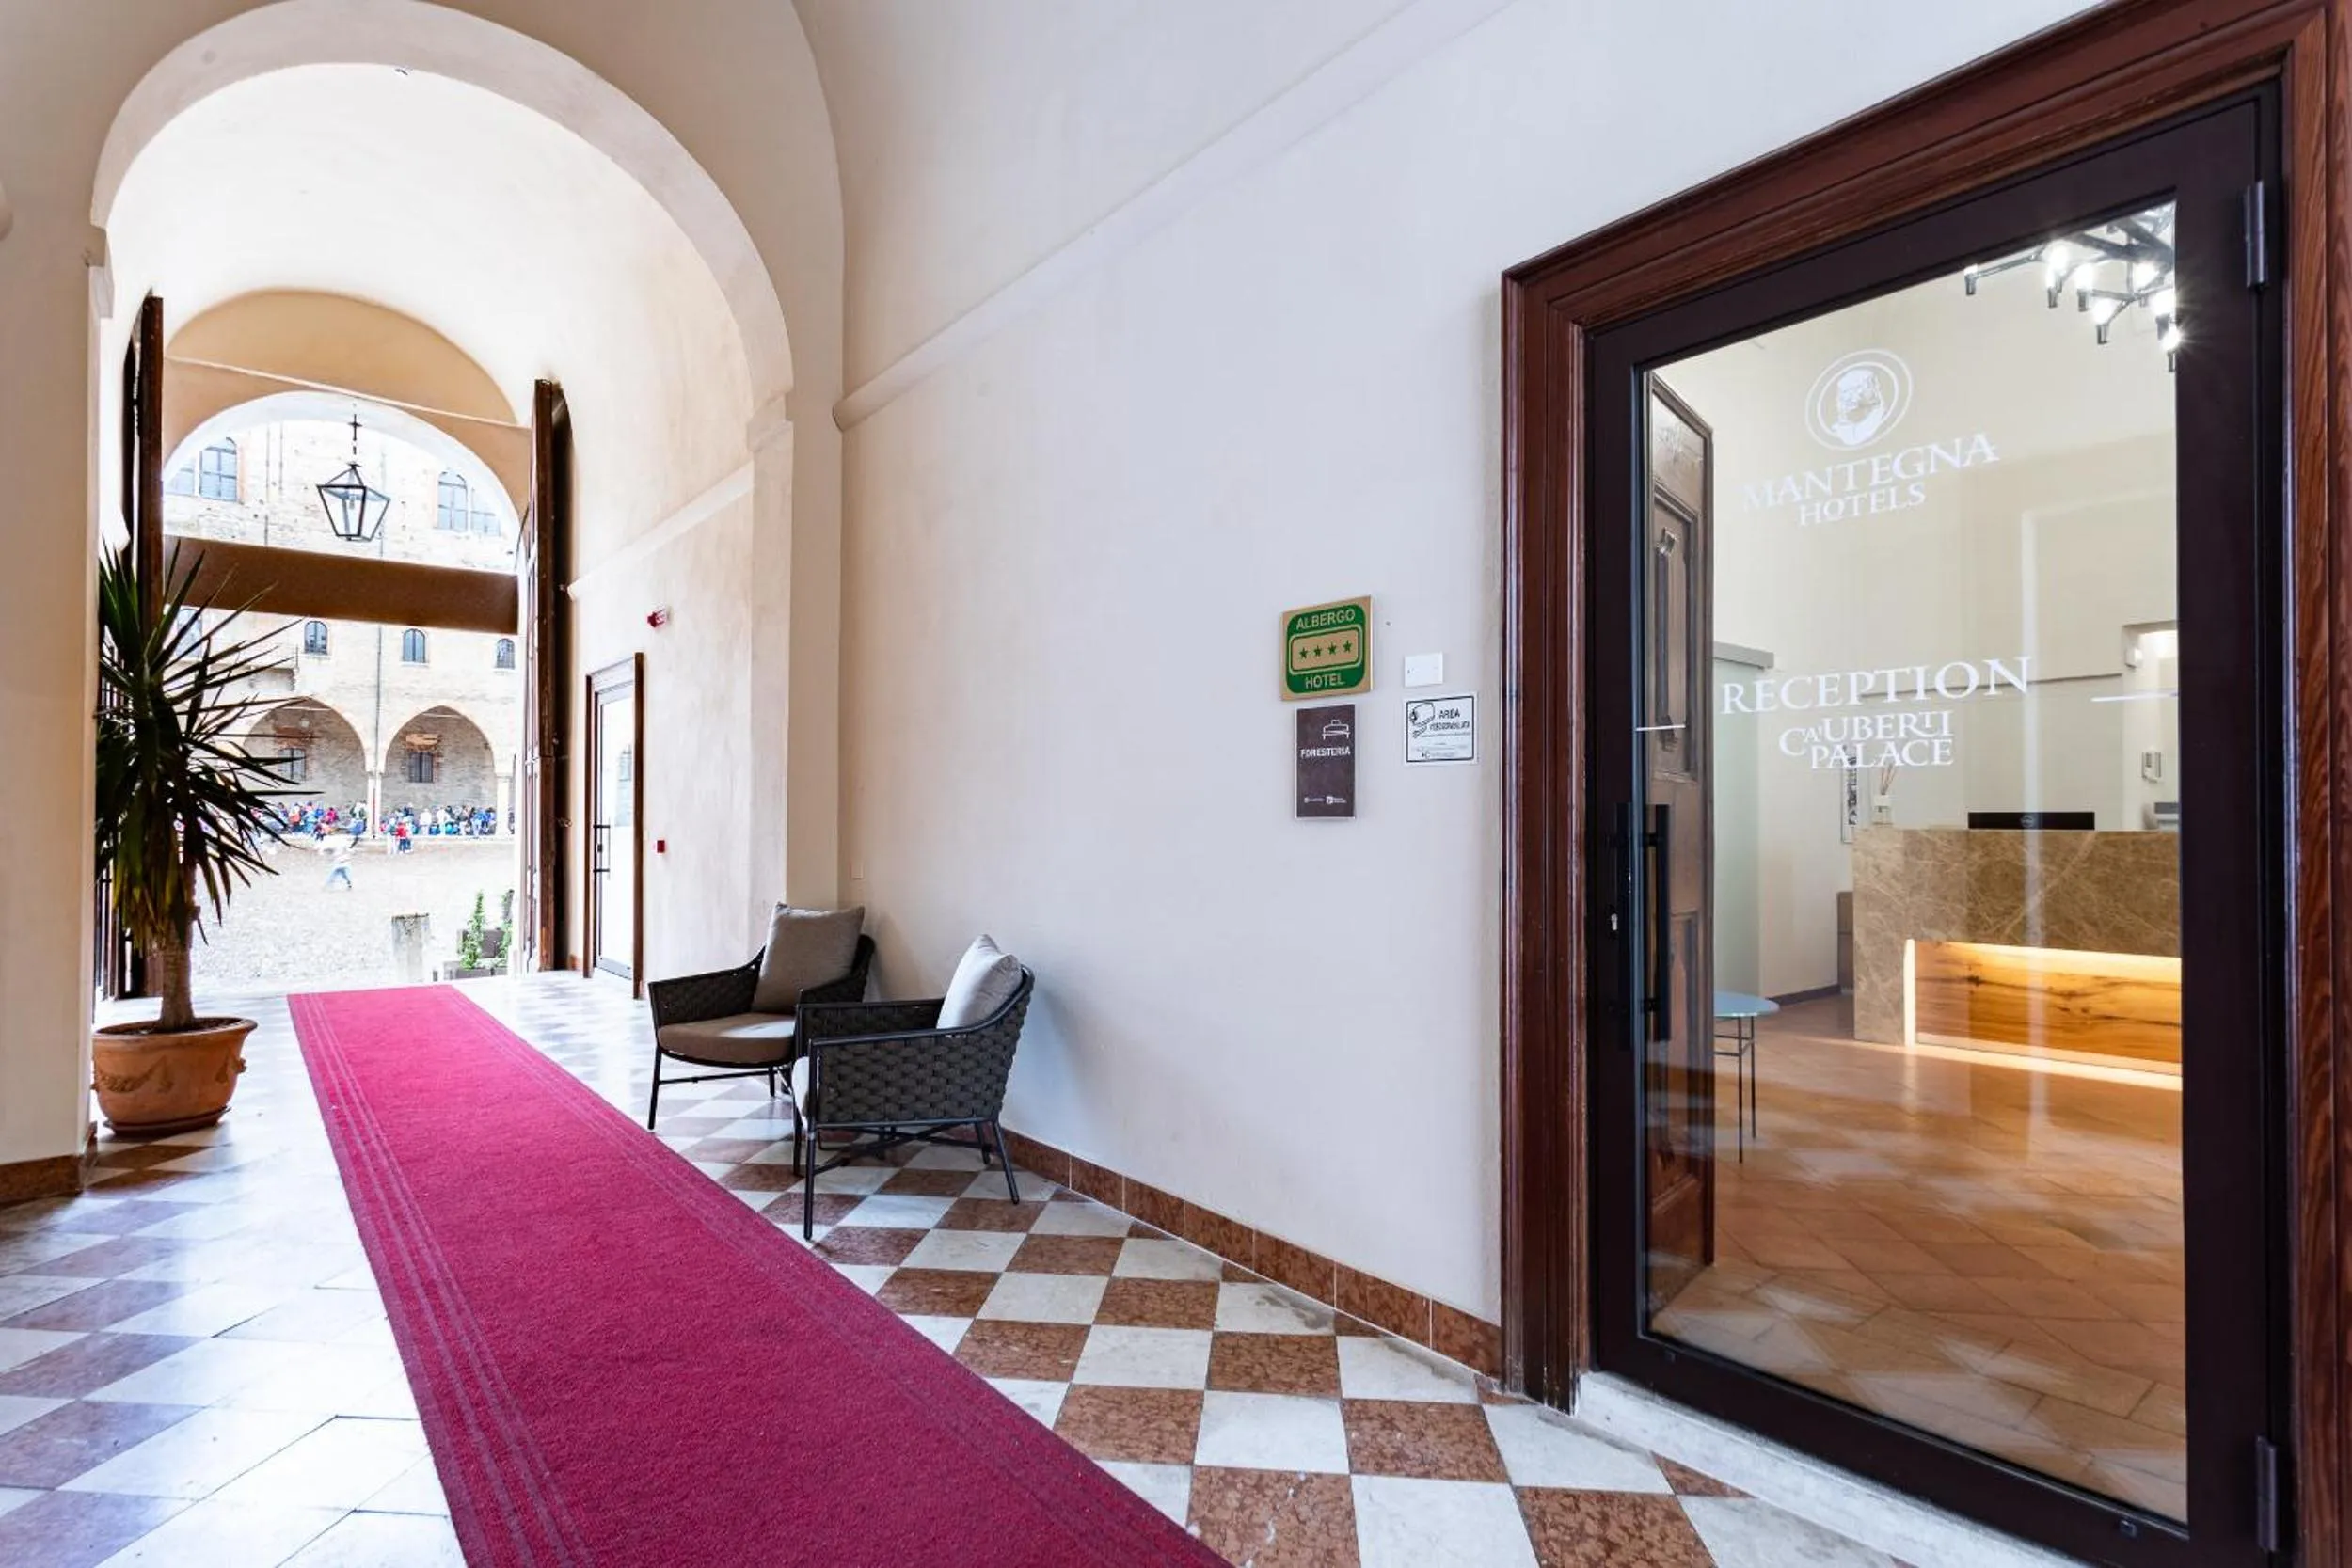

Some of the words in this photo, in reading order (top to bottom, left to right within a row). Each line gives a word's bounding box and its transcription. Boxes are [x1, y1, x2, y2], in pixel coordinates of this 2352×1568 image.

[1740, 433, 2000, 511] MANTEGNA
[1798, 482, 1926, 527] HOTELS
[1296, 609, 1355, 630] ALBERGO
[1305, 673, 1344, 689] HOTEL
[1720, 656, 2031, 715] RECEPTION
[1300, 746, 1351, 759] FORESTERIA
[1810, 738, 1954, 770] PALACE
